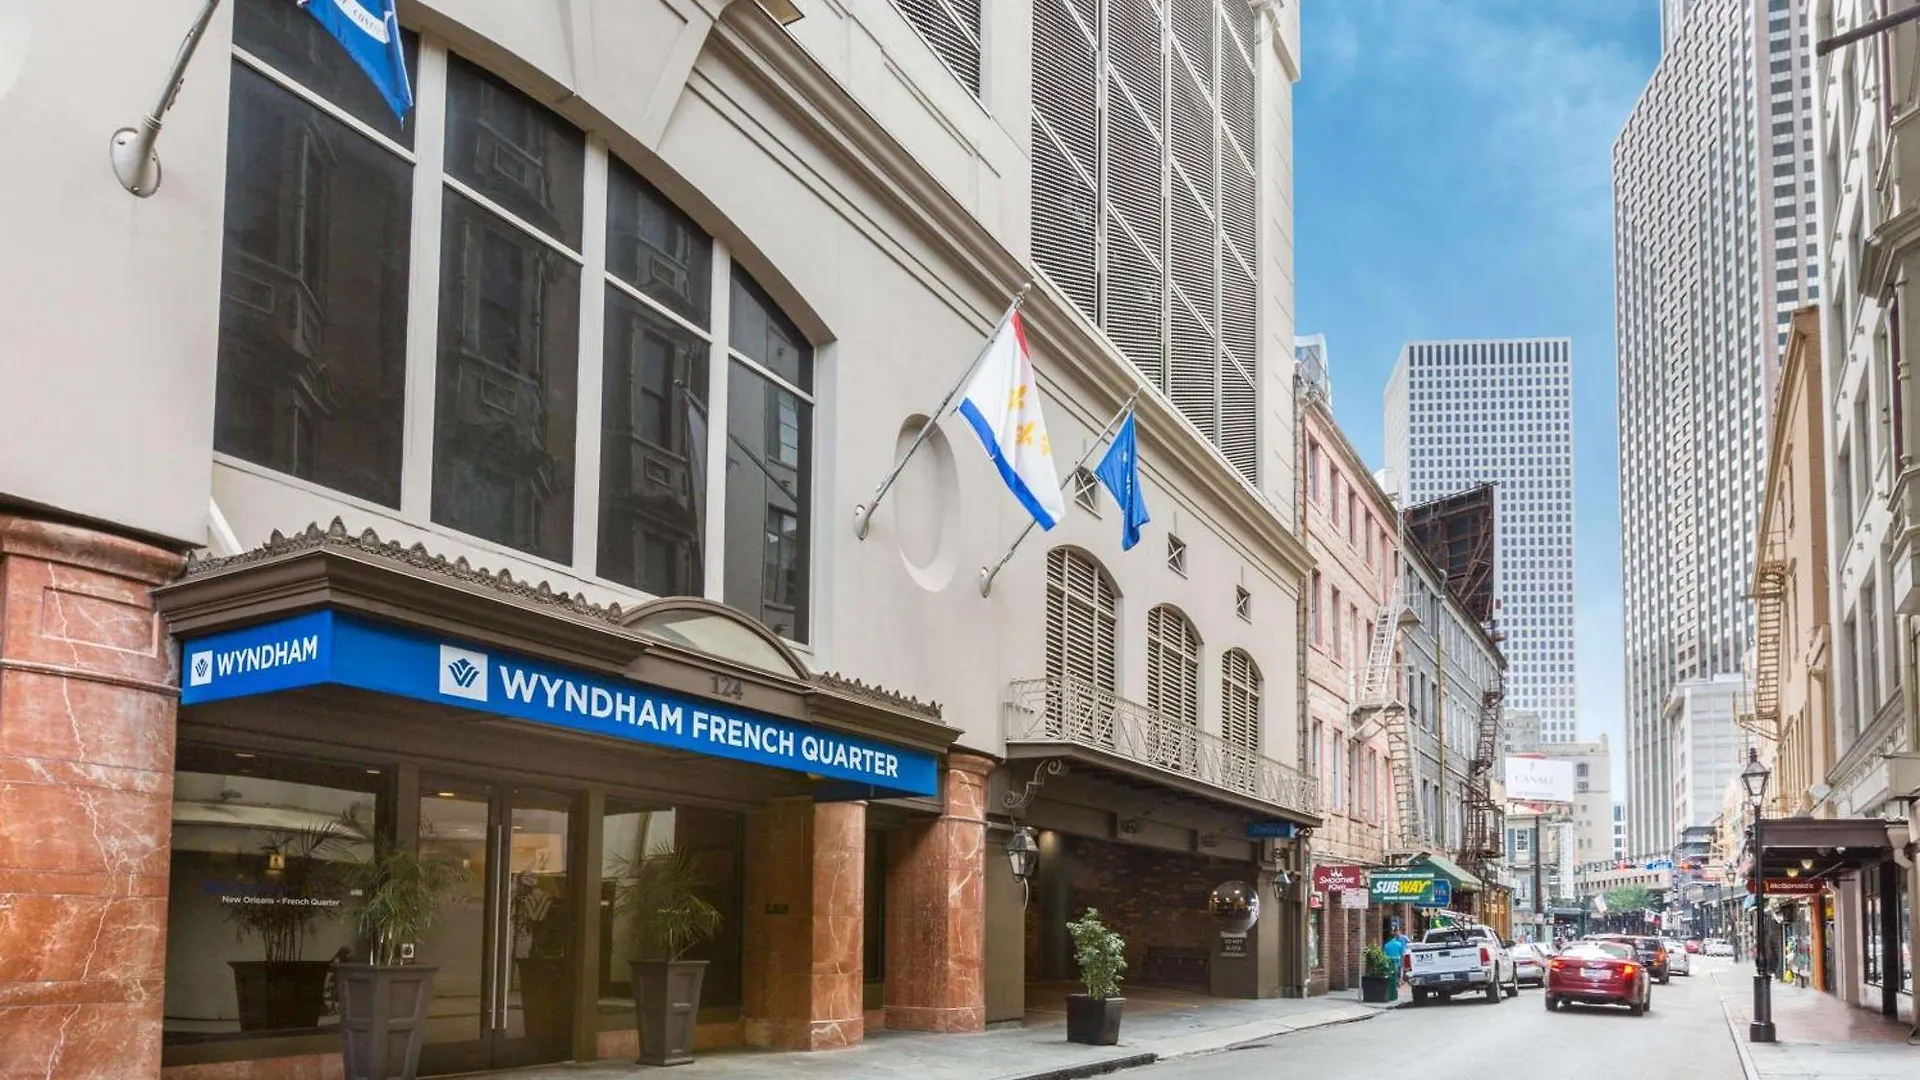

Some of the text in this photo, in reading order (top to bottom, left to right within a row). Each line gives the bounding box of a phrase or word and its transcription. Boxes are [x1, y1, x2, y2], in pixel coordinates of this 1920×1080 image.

[217, 635, 318, 677] WYNDHAM
[710, 673, 743, 700] 124
[499, 664, 899, 778] WYNDHAM FRENCH QUARTER
[1372, 880, 1430, 894] SUBWAY
[222, 895, 241, 904] New
[243, 896, 275, 905] Orleans
[282, 897, 309, 906] French
[311, 898, 340, 907] Quarter
